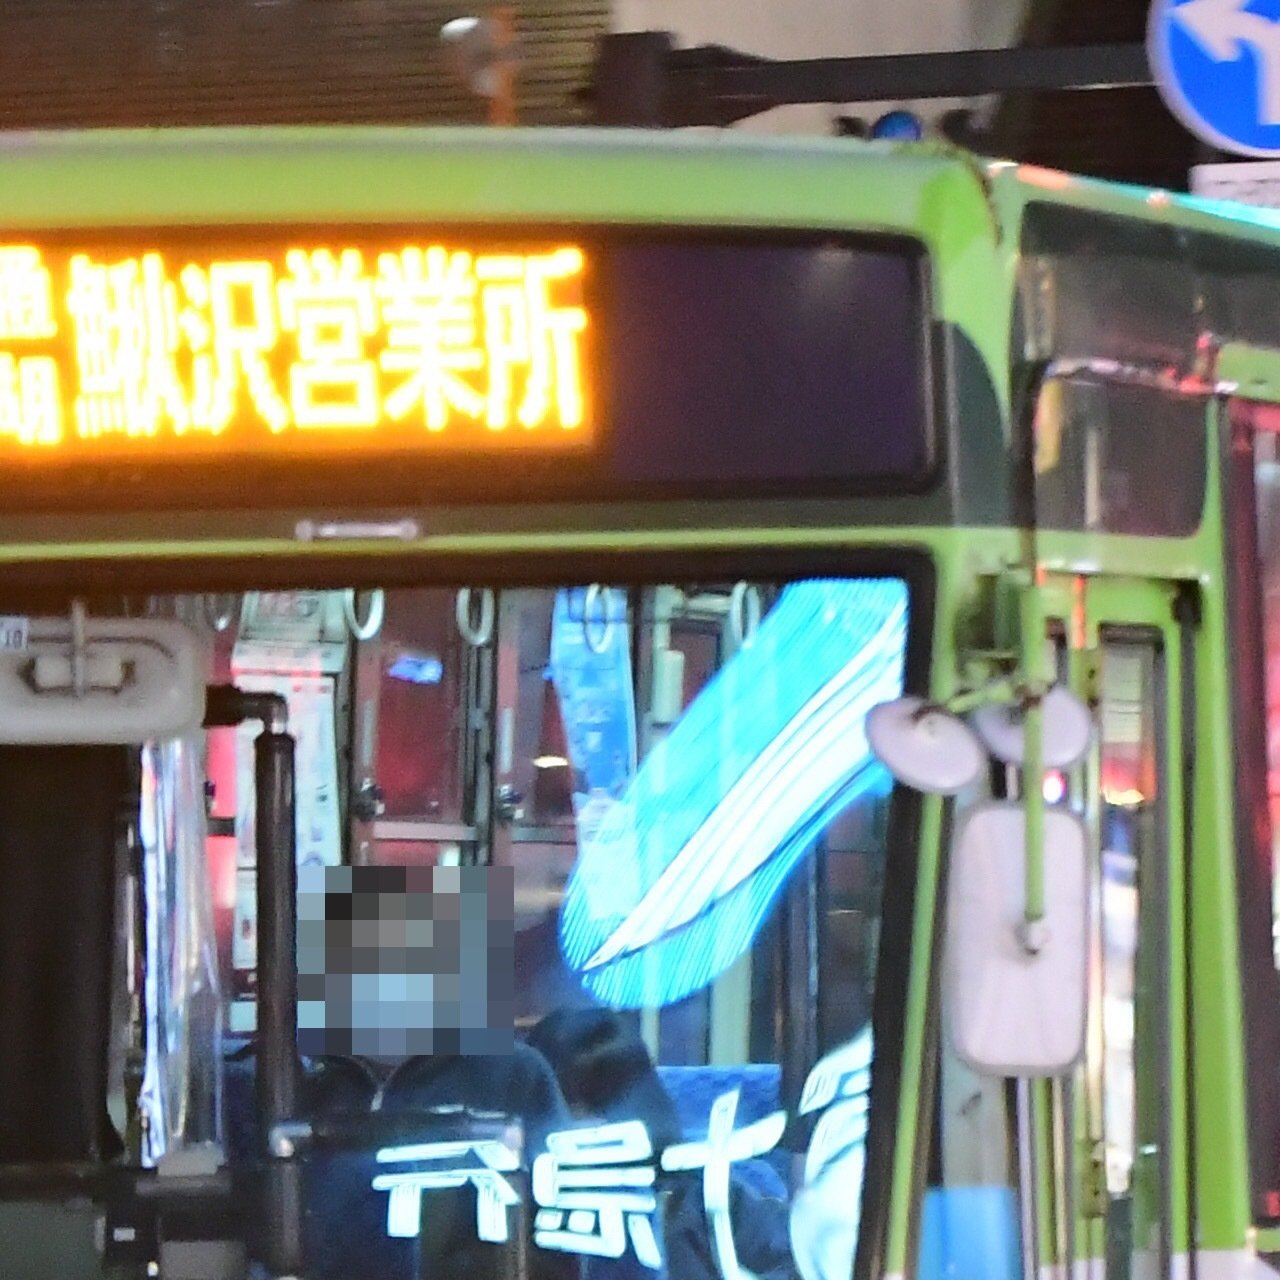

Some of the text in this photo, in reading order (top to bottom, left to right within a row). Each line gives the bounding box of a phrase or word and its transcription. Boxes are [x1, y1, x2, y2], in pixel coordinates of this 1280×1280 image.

[68, 247, 589, 437] 鰍沢営業所
